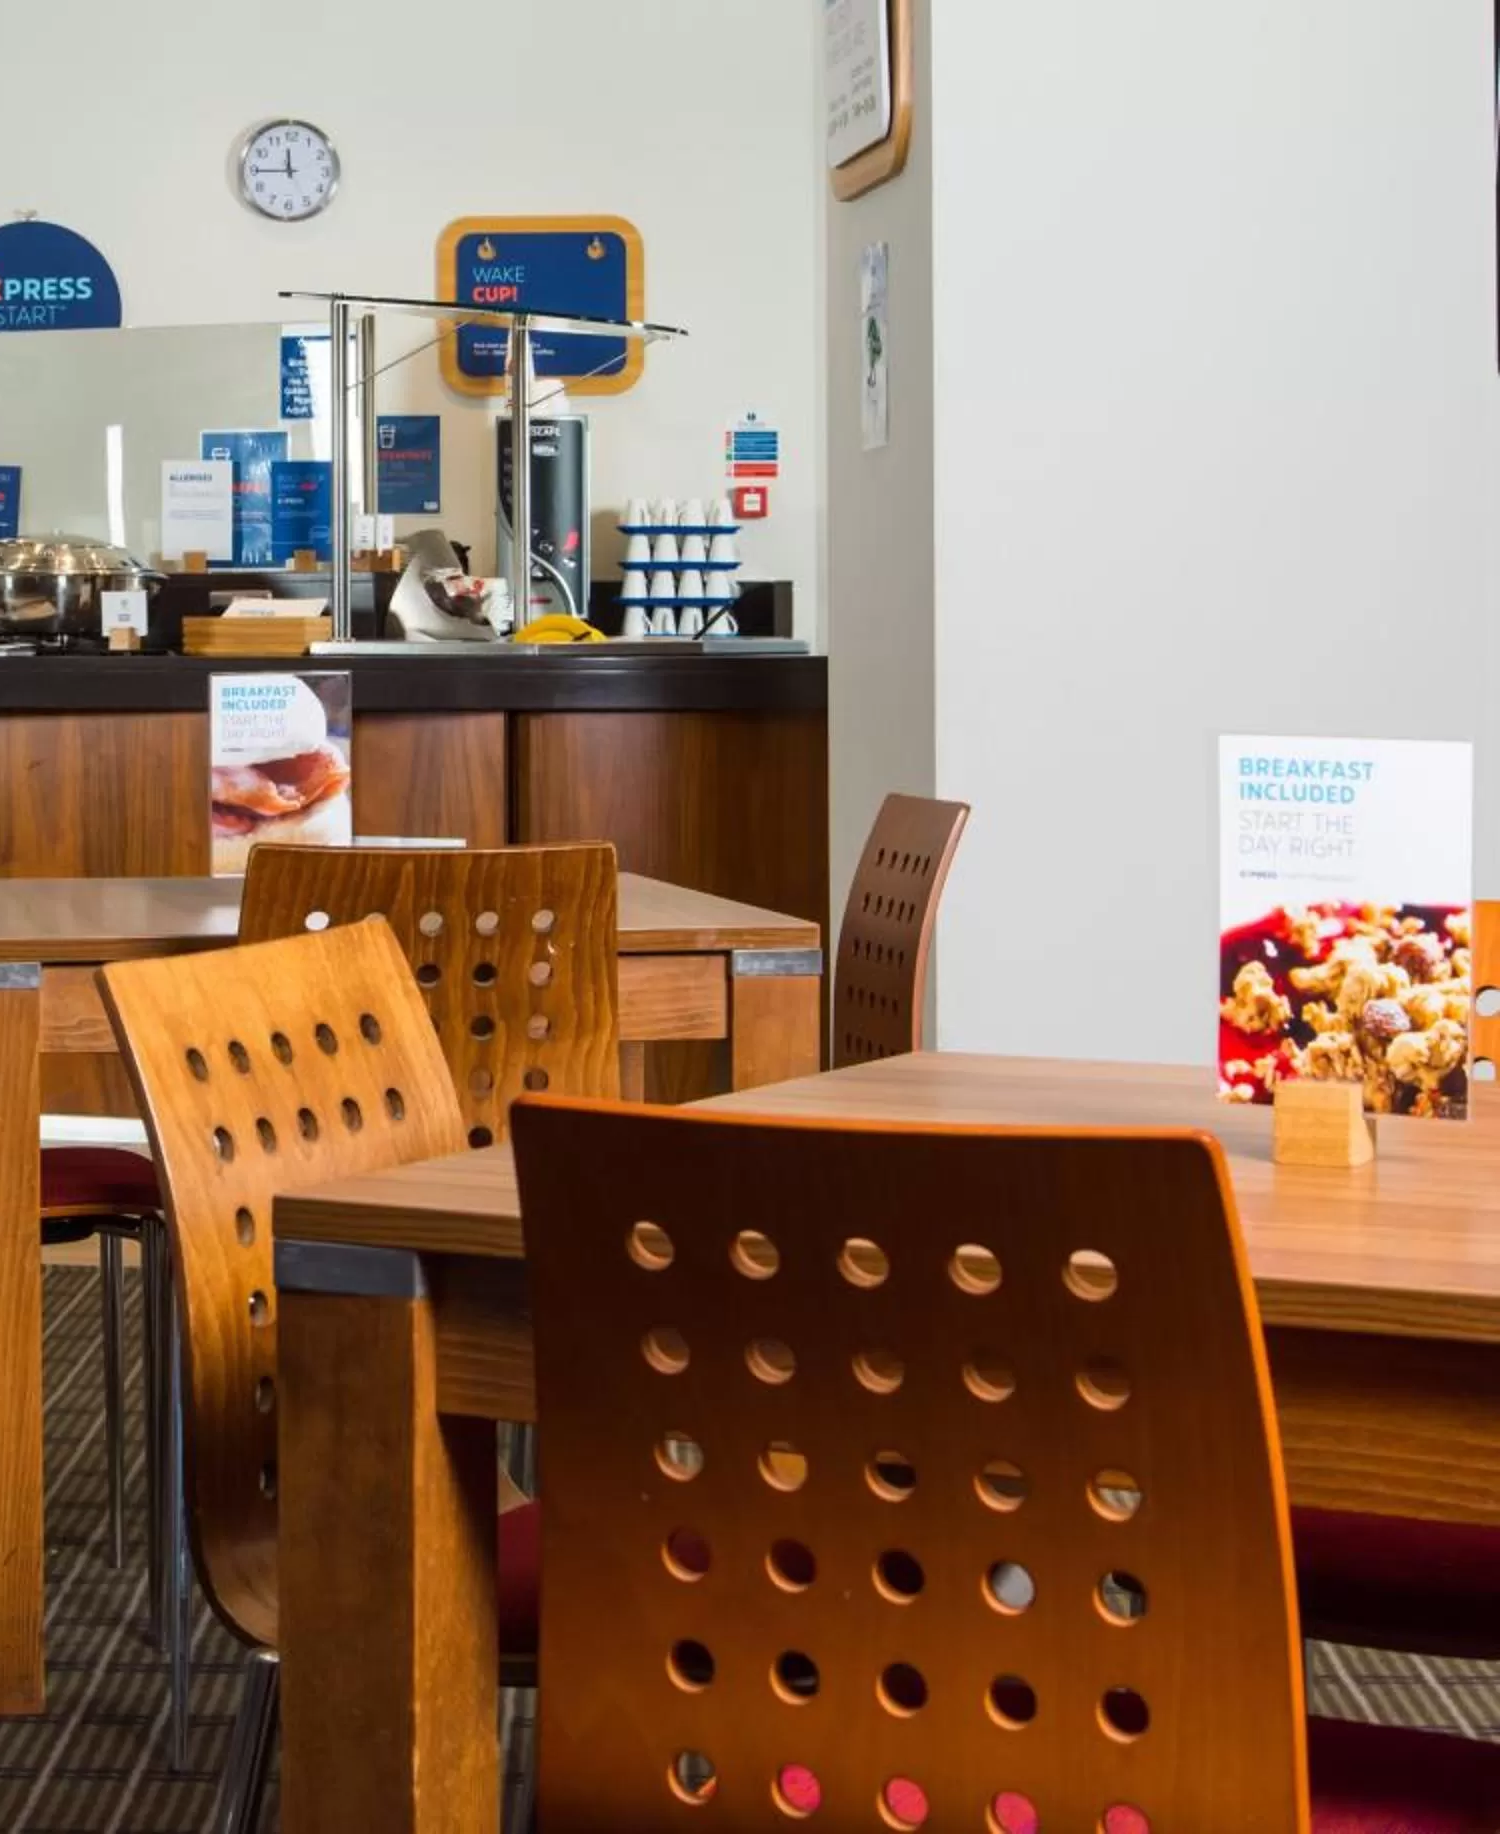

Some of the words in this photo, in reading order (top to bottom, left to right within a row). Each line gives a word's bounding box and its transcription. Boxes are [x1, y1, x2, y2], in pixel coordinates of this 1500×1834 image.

[472, 267, 526, 283] WAKE
[472, 286, 518, 302] CUP!
[221, 686, 296, 697] BREAKFAST
[221, 699, 287, 711] INCLUDED
[1238, 757, 1373, 780] BREAKFAST
[1239, 782, 1356, 805] INCLUDED
[1238, 810, 1304, 832] START
[1312, 813, 1353, 835] THE
[1238, 834, 1282, 857] DAY
[1289, 835, 1355, 859] RIGHT
